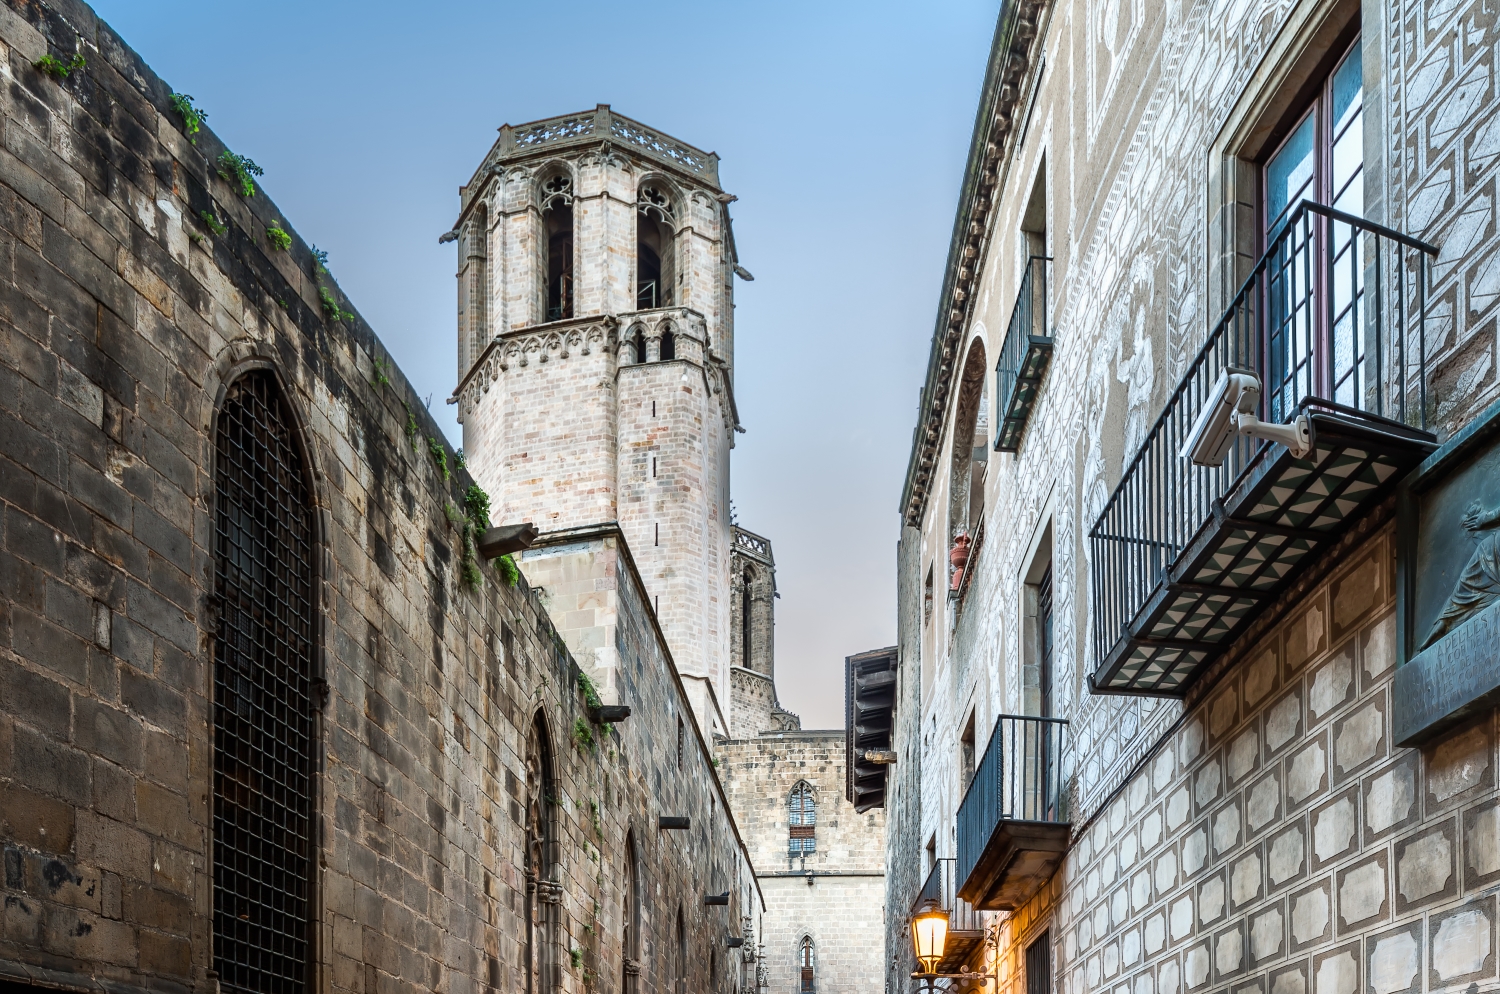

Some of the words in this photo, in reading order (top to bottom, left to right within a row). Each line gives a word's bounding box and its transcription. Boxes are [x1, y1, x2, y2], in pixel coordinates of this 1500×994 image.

[1447, 645, 1465, 665] COR
[1470, 634, 1481, 651] DE
[1460, 654, 1471, 671] DE
[1474, 644, 1486, 663] LA
